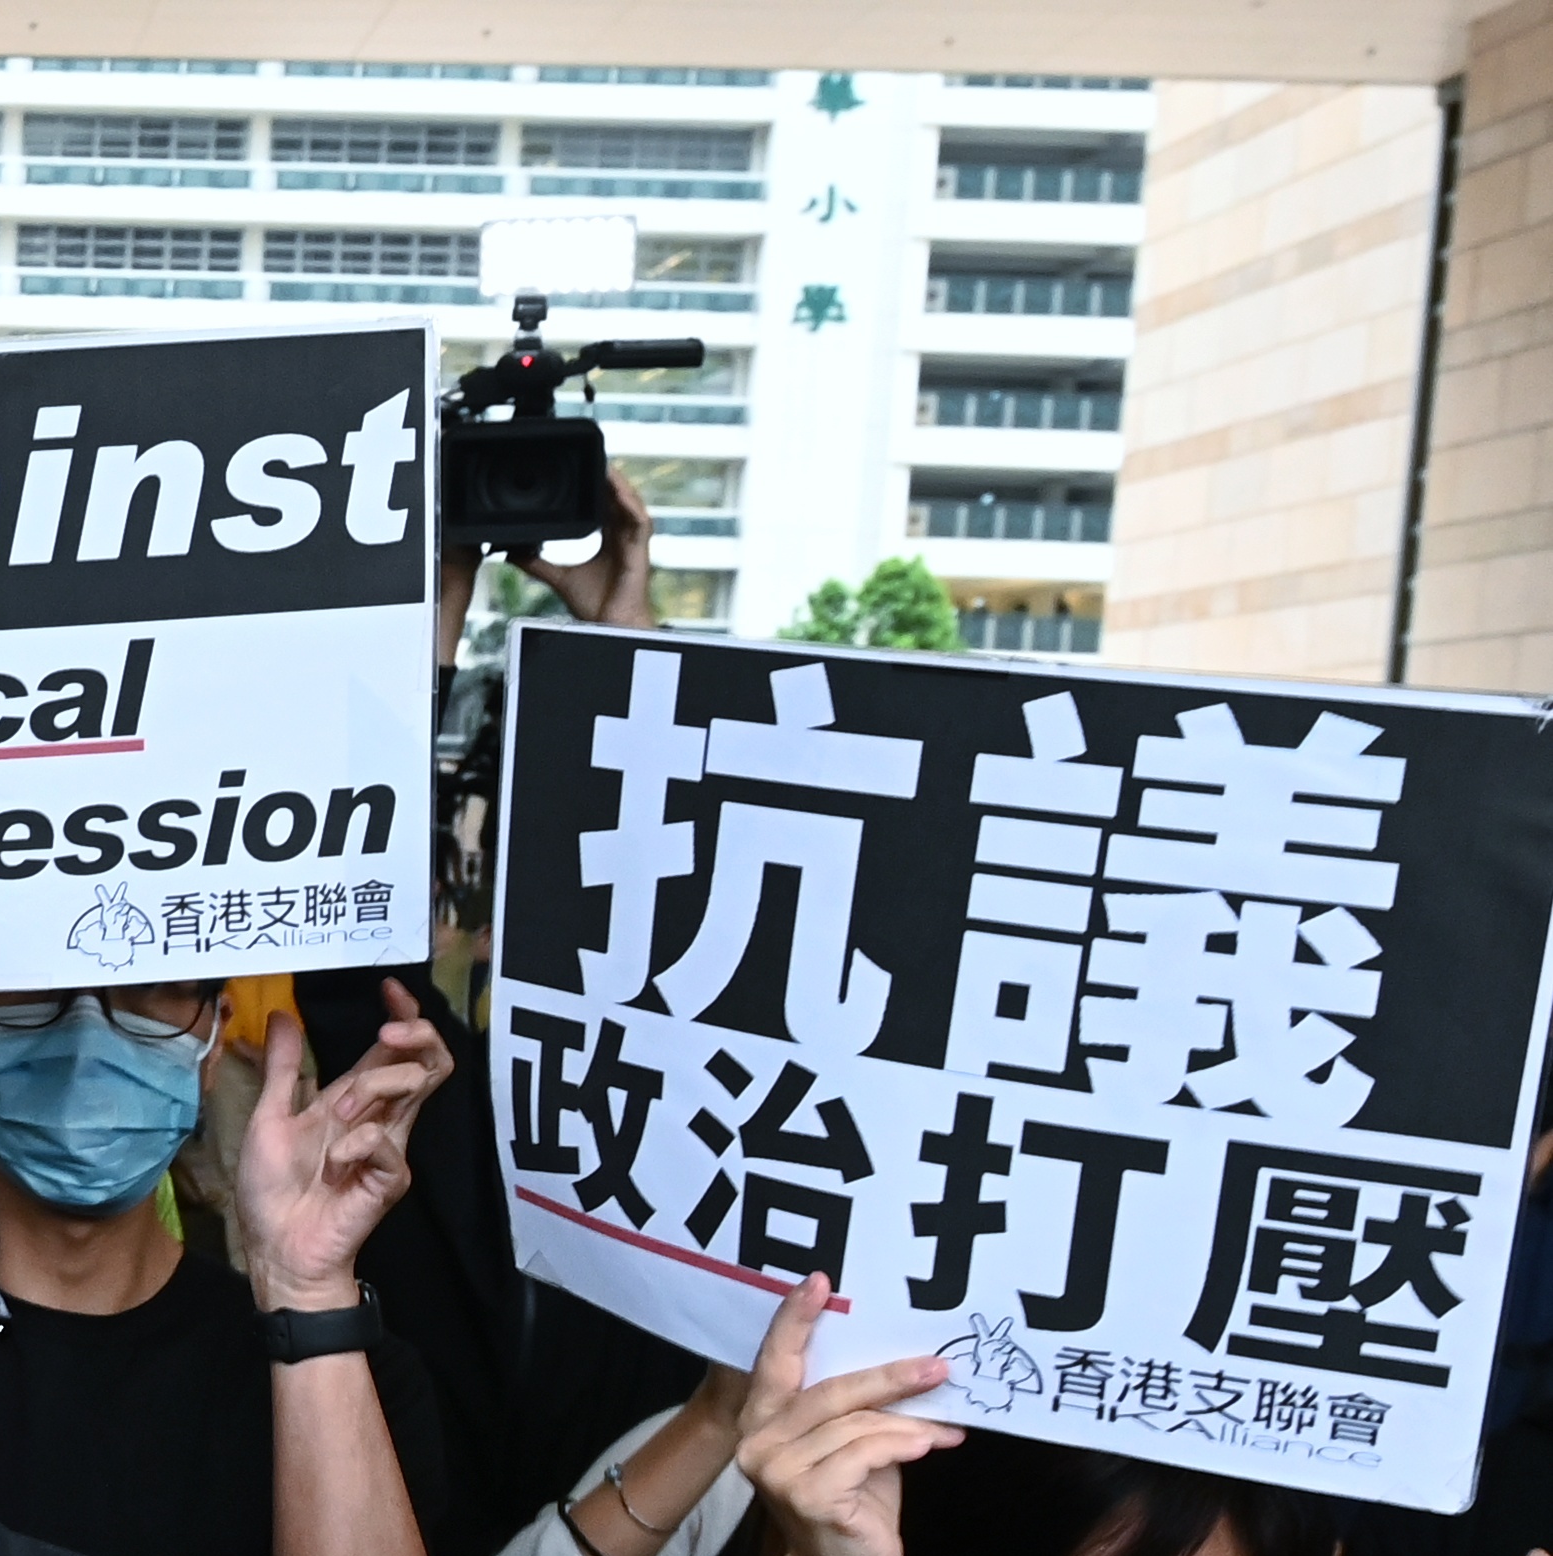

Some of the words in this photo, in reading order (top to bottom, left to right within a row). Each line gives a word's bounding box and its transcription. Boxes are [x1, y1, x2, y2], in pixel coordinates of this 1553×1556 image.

[161, 879, 394, 937] 香港支聯會
[578, 648, 1408, 1128] 抗議
[508, 1006, 1483, 1389] 政治打壓
[1055, 1346, 1393, 1447] 香港支聯會
